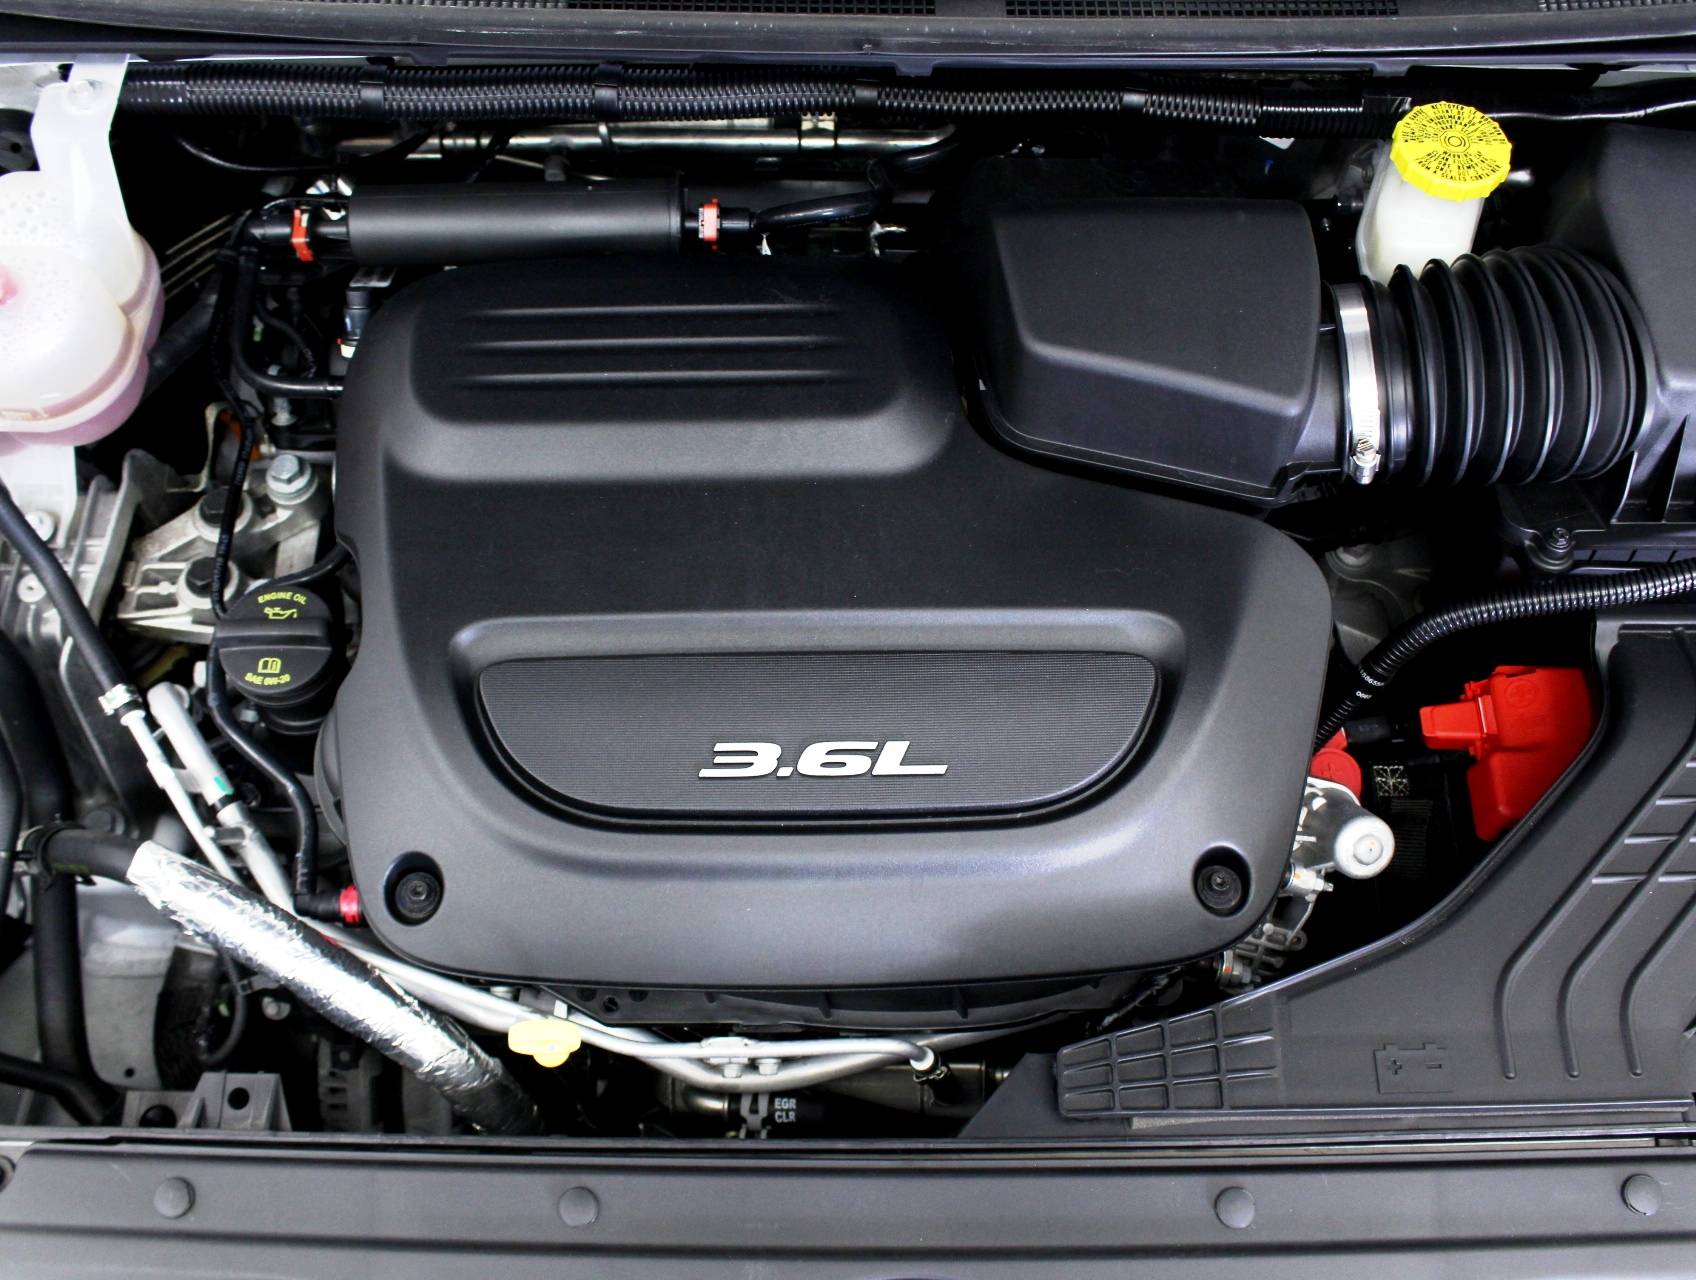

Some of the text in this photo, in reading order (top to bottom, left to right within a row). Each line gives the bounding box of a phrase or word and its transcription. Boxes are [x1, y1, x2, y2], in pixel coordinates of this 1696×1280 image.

[257, 591, 307, 605] ENGINE OIL
[698, 740, 949, 778] 3.6L
[774, 1097, 797, 1110] EGR
[774, 1110, 796, 1123] CLR
